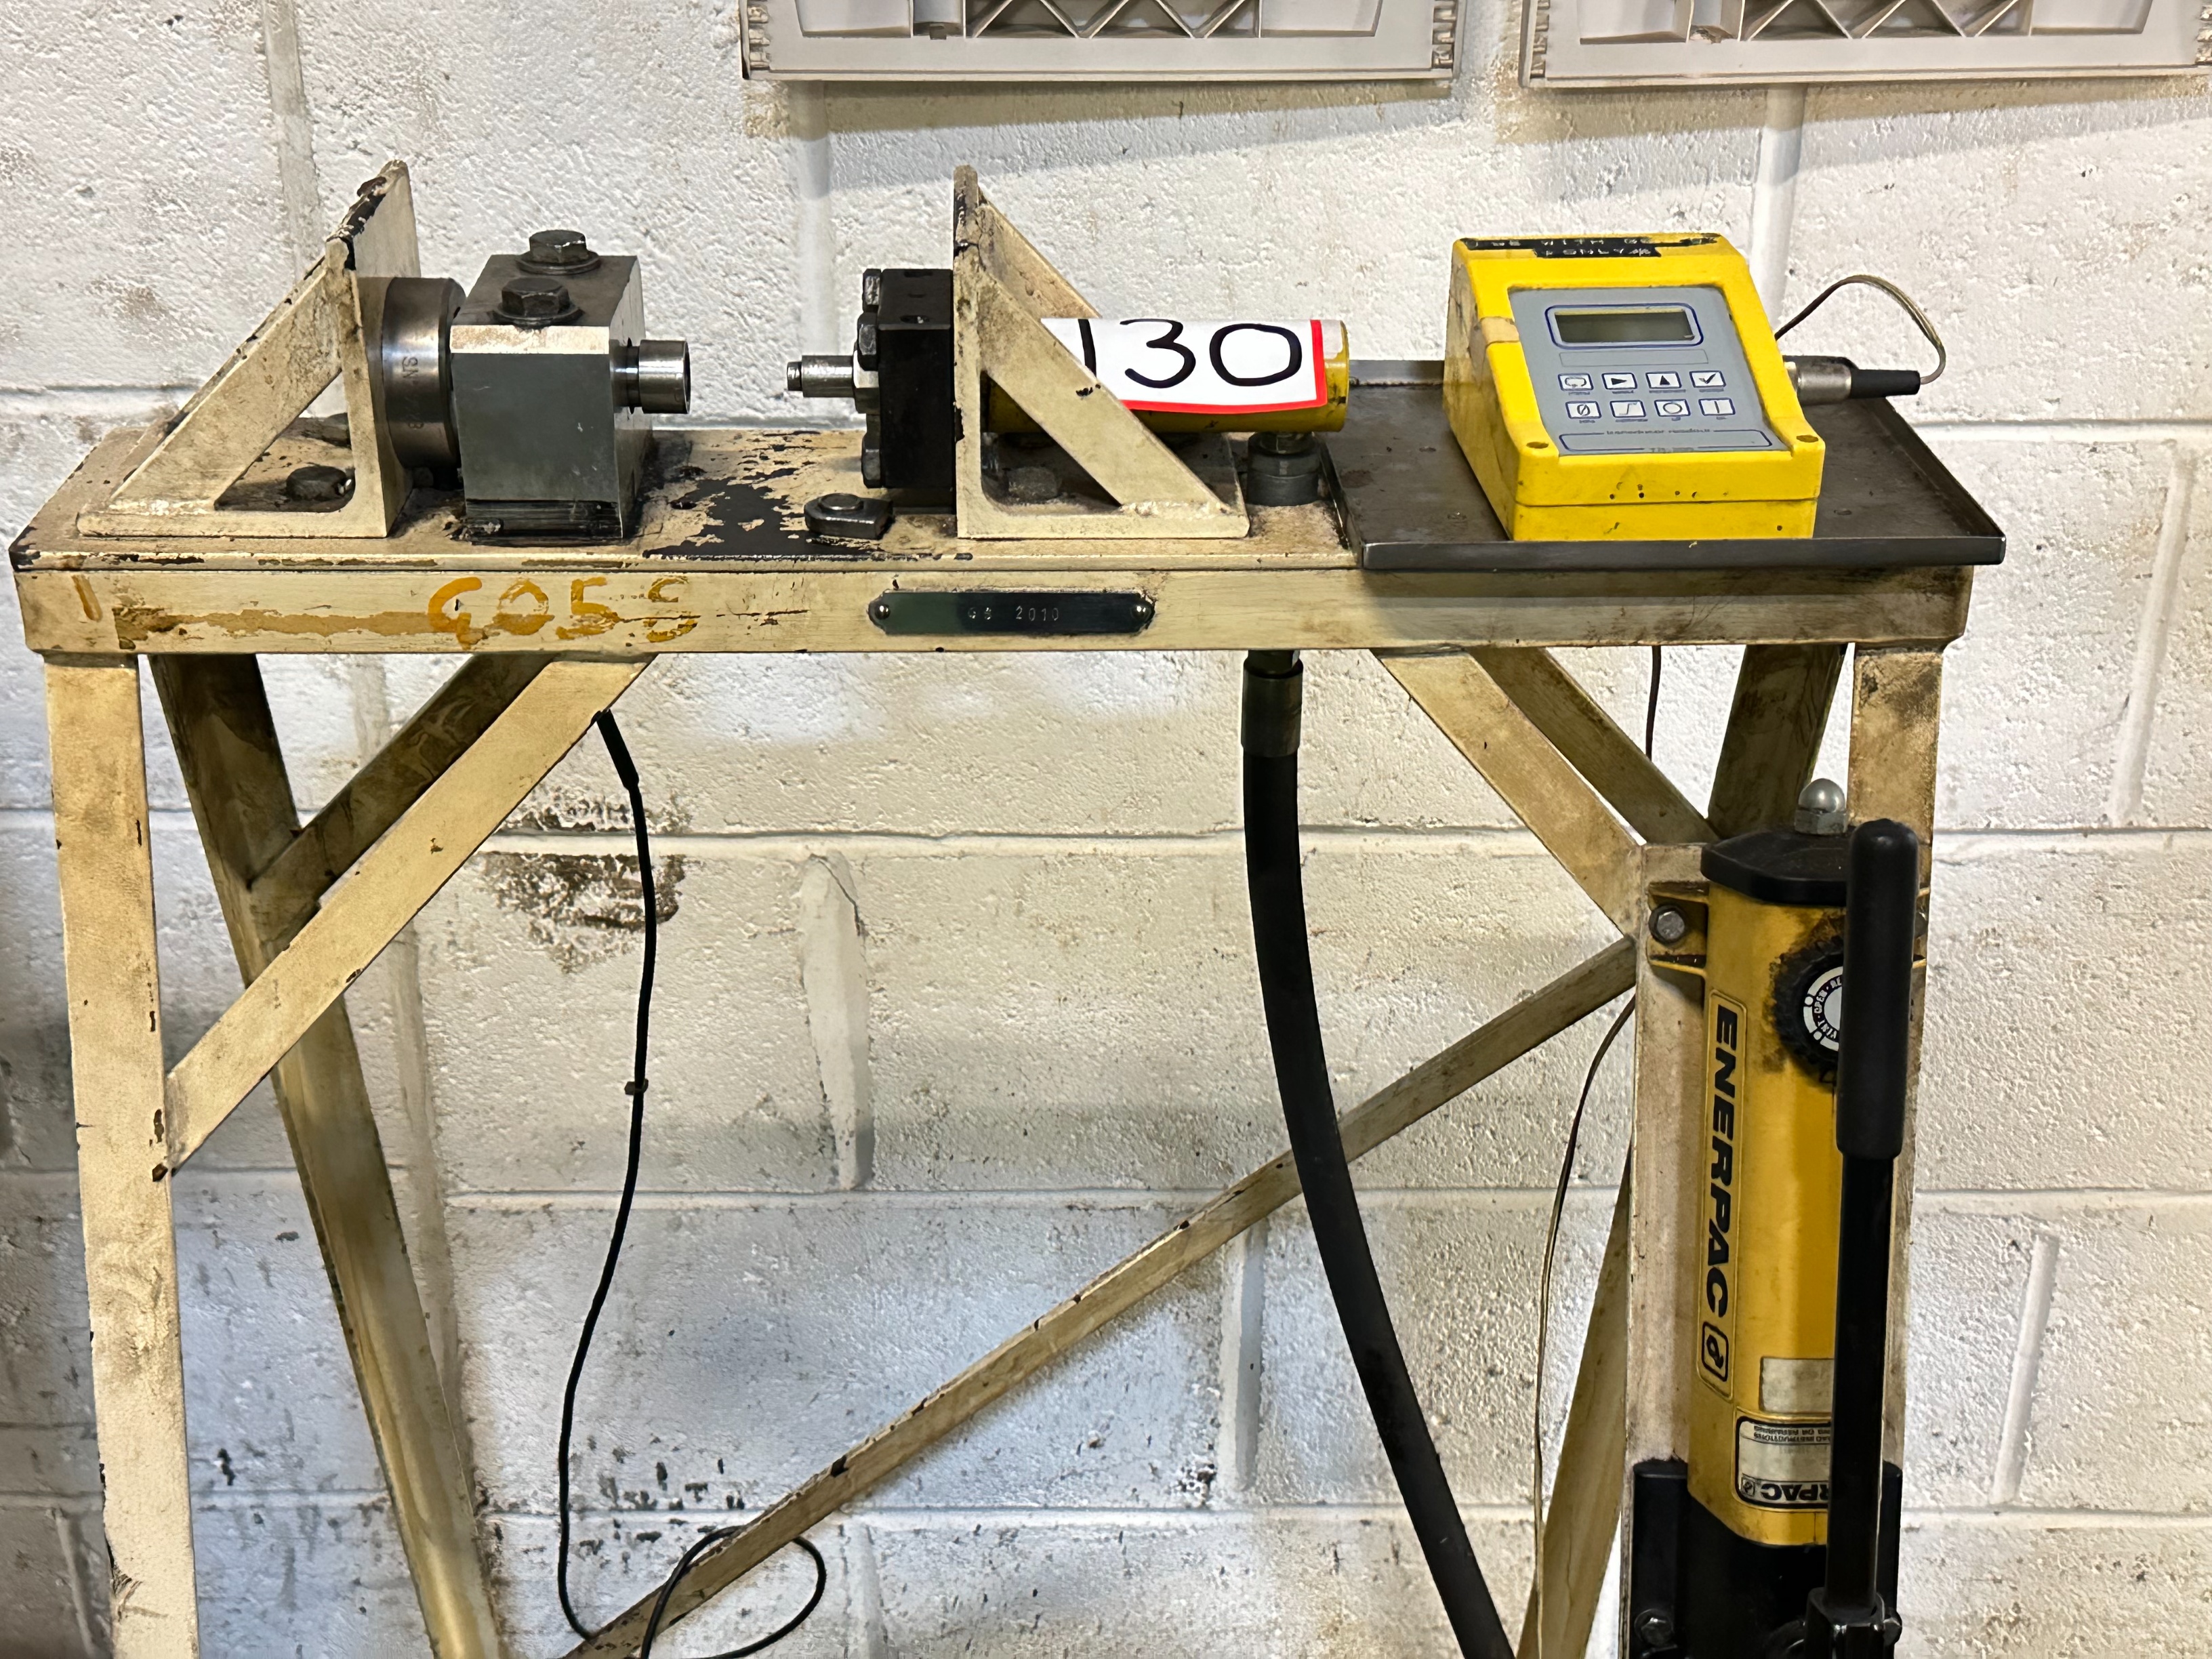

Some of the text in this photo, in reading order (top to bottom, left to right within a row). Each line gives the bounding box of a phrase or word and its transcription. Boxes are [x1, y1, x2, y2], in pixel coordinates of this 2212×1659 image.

[1078, 319, 1303, 388] 130
[1015, 605, 1059, 621] 2010
[1706, 1004, 1738, 1318] ENERPAC
[1761, 1483, 1829, 1500] RPAC
